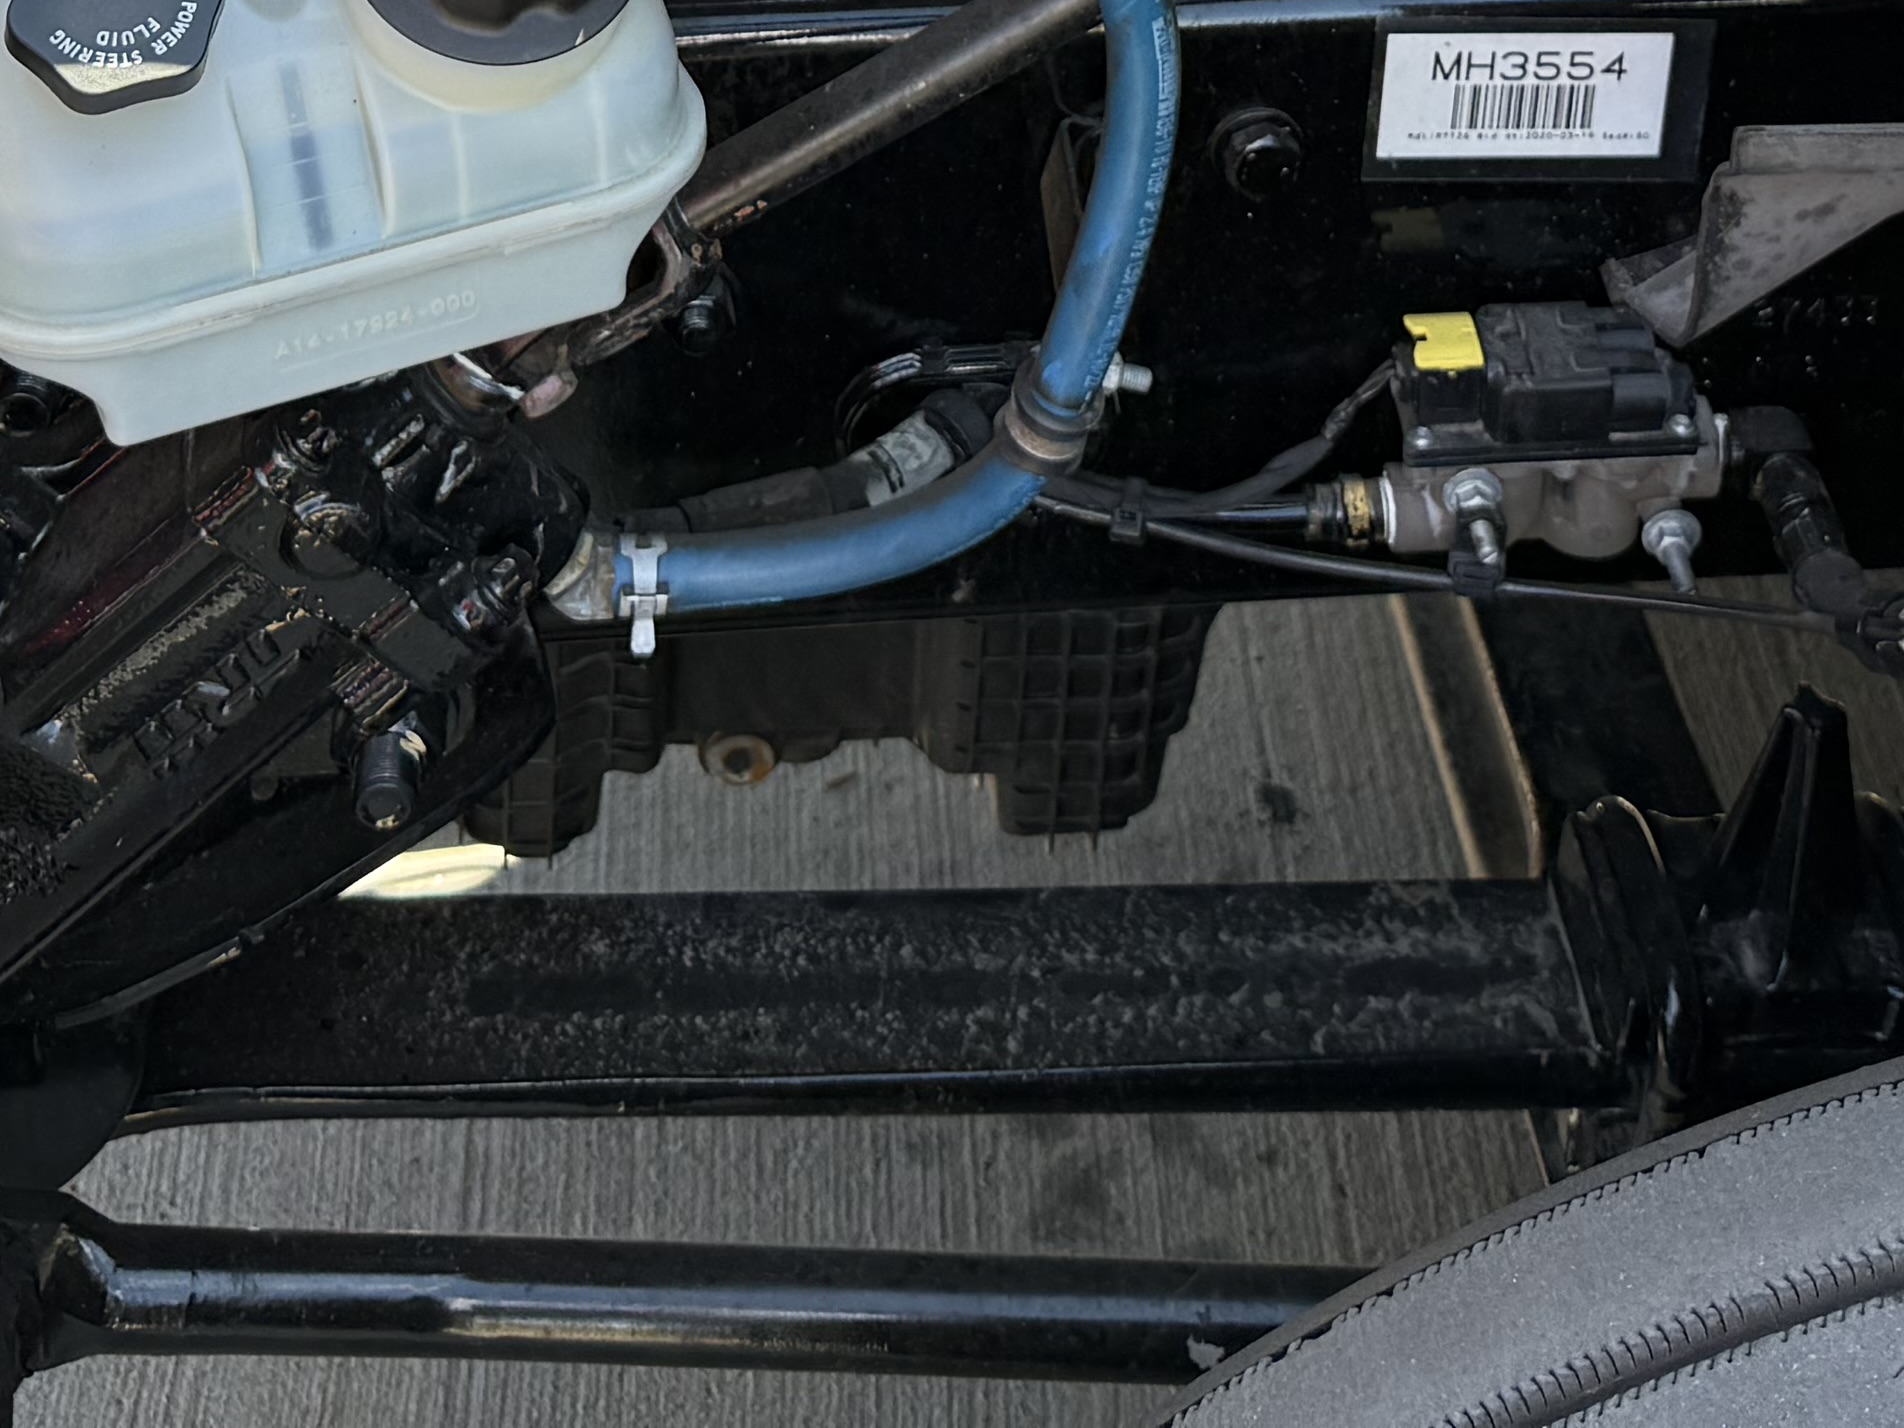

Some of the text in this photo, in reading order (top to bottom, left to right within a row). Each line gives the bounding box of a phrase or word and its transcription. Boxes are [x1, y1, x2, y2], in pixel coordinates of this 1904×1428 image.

[49, 1, 197, 68] POWER STEERING
[96, 17, 161, 47] FLUID
[1431, 51, 1628, 82] MH3554
